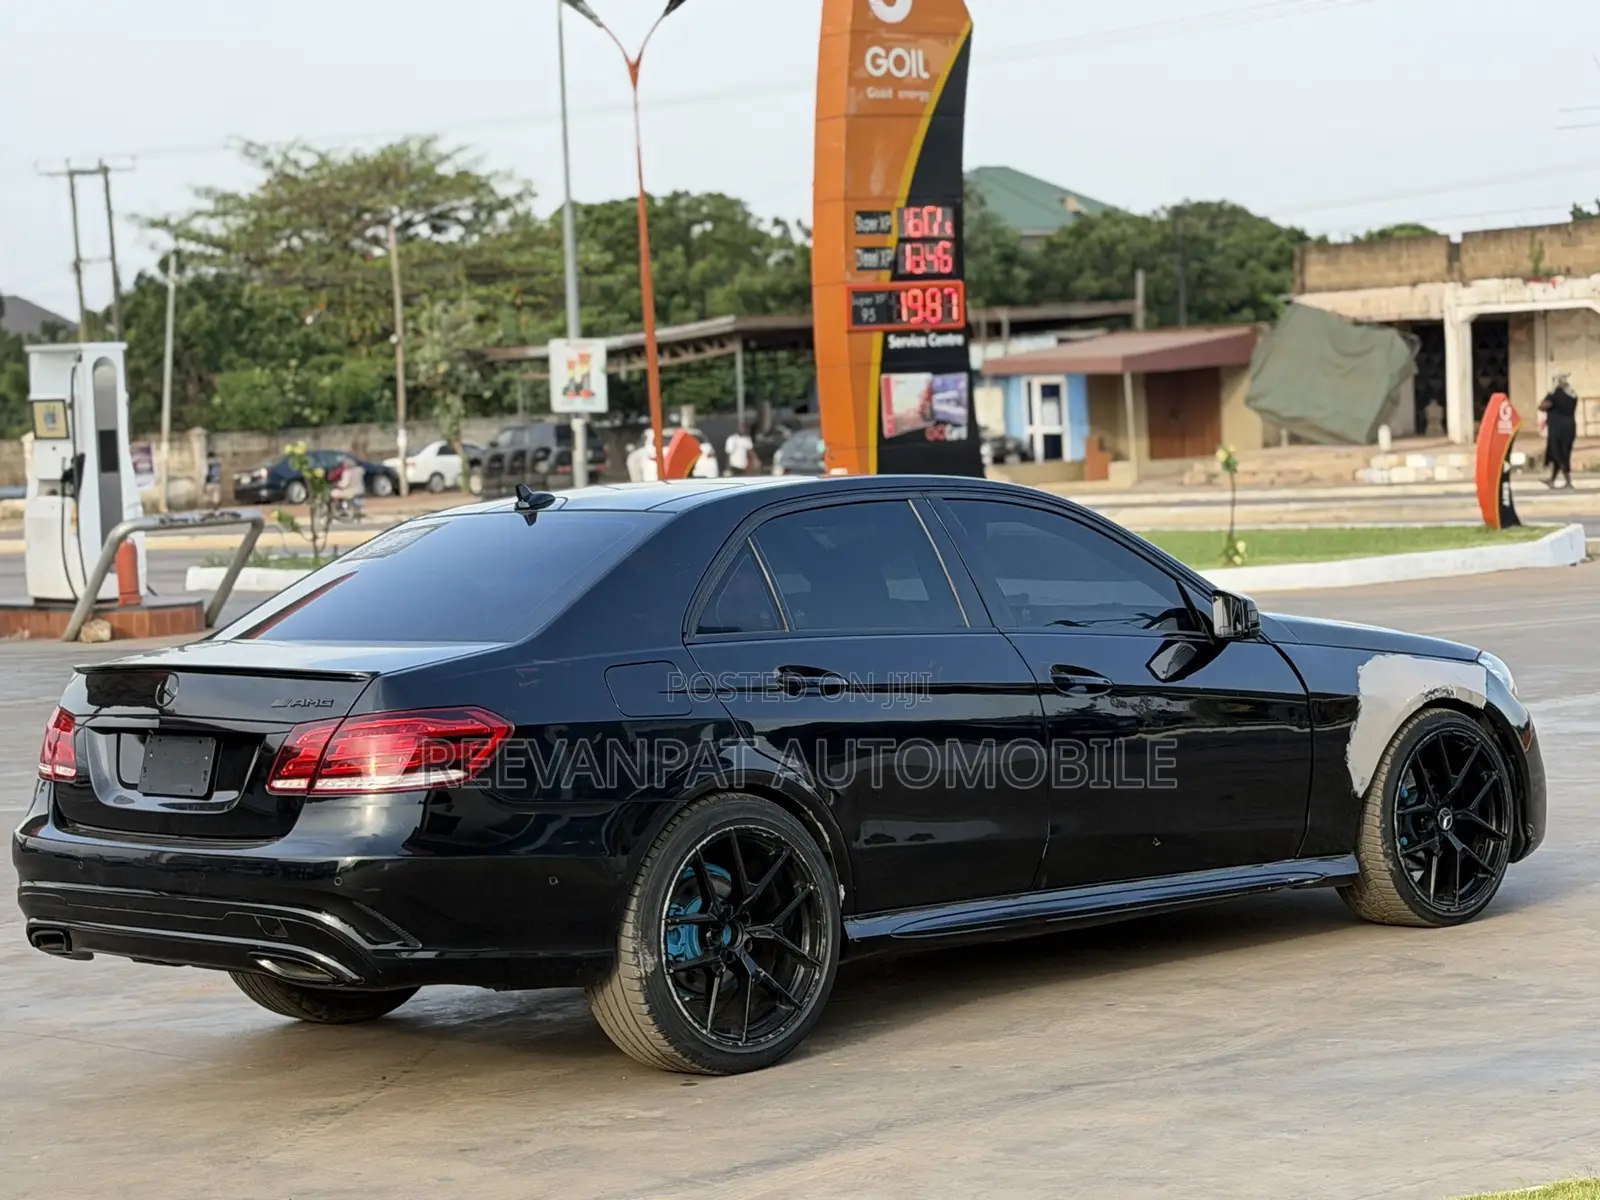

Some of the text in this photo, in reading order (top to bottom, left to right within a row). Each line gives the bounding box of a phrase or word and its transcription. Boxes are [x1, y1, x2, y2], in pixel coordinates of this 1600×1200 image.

[865, 46, 930, 79] GOIL
[861, 307, 877, 322] 95
[900, 287, 958, 325] 1987
[888, 332, 964, 349] Service Centre
[288, 698, 335, 708] AMG
